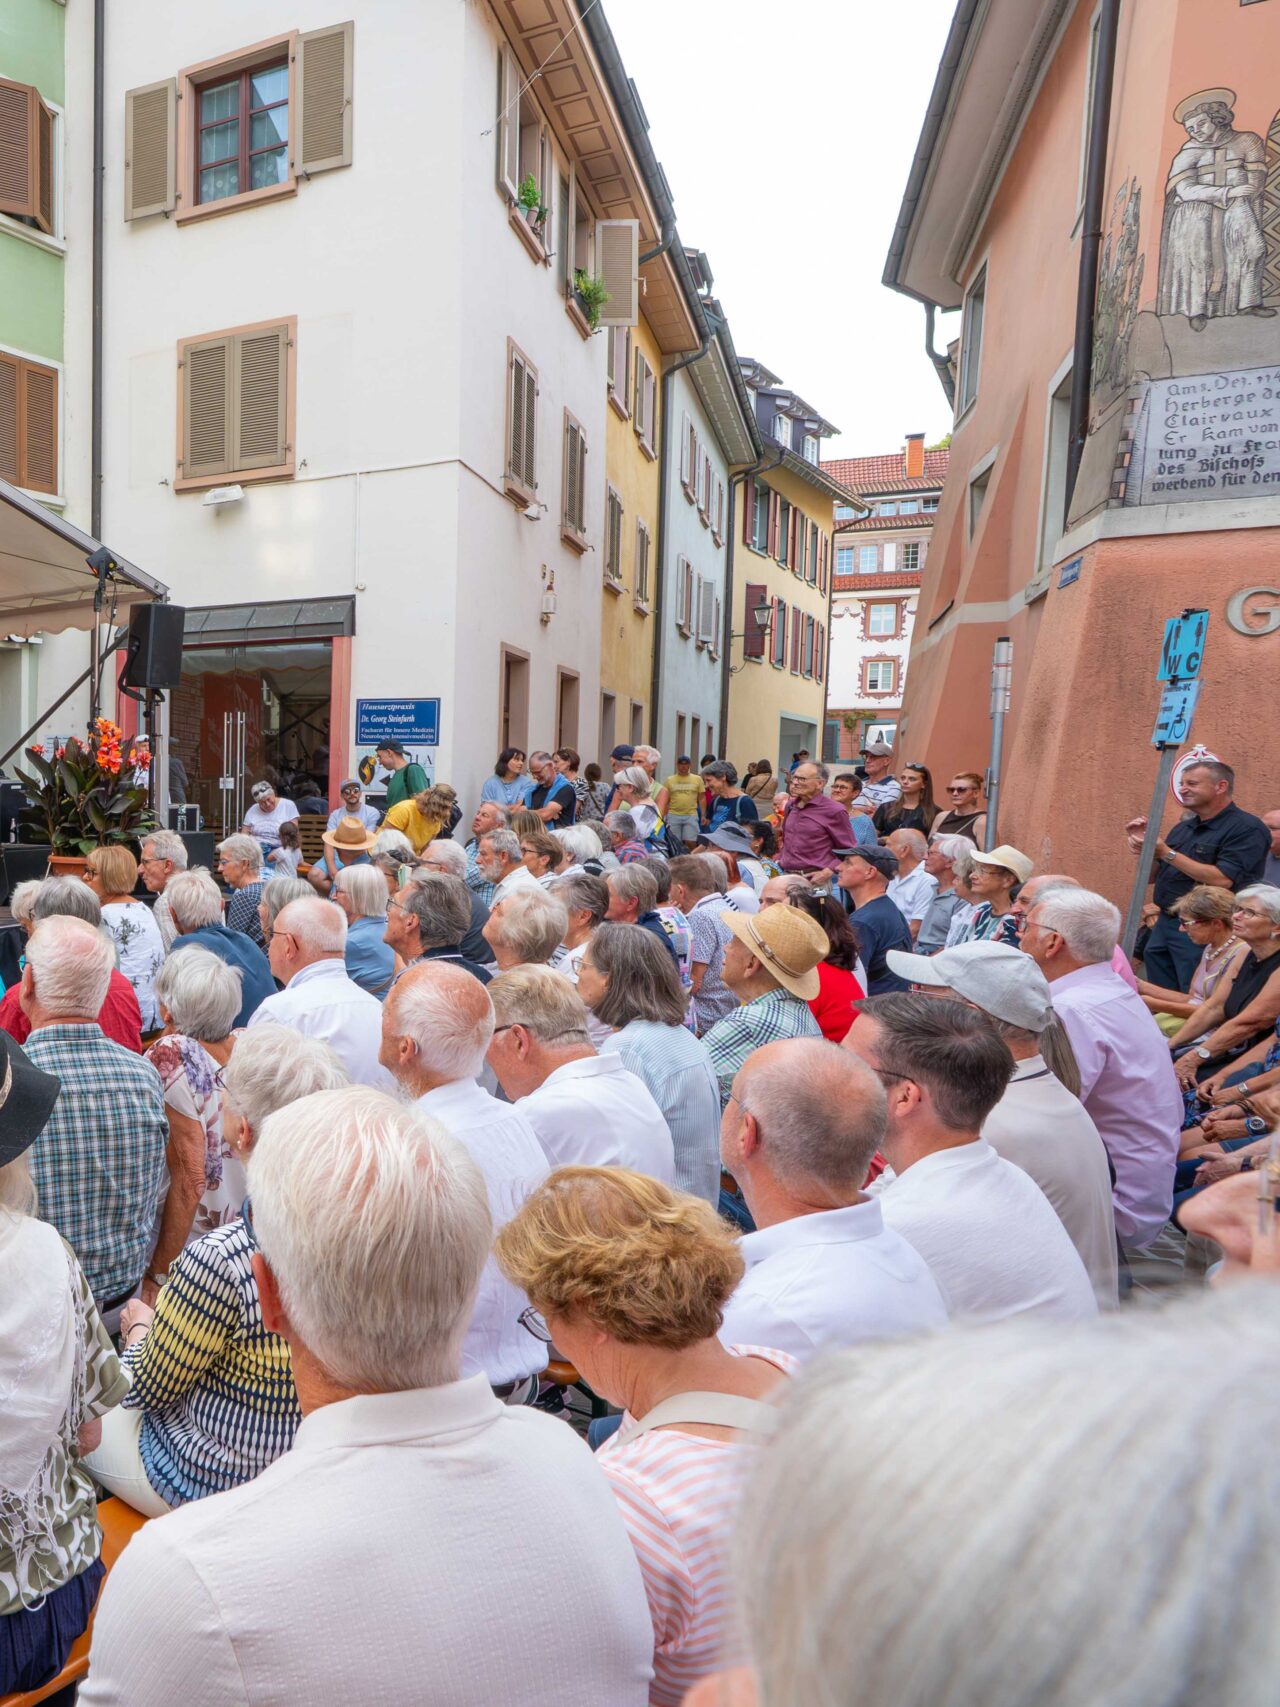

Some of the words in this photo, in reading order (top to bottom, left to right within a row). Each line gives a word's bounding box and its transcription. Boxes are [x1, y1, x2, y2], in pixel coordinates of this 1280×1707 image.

[1164, 407, 1273, 429] Clairvaux
[1164, 430, 1187, 446] Er
[1248, 423, 1279, 433] von
[1157, 462, 1186, 476] des
[1151, 475, 1216, 492] werbend
[1222, 472, 1247, 488] für
[1226, 586, 1280, 636] G
[362, 703, 415, 711] Hausarztpraxis
[361, 714, 370, 723] Dr.
[370, 714, 388, 725] Georg
